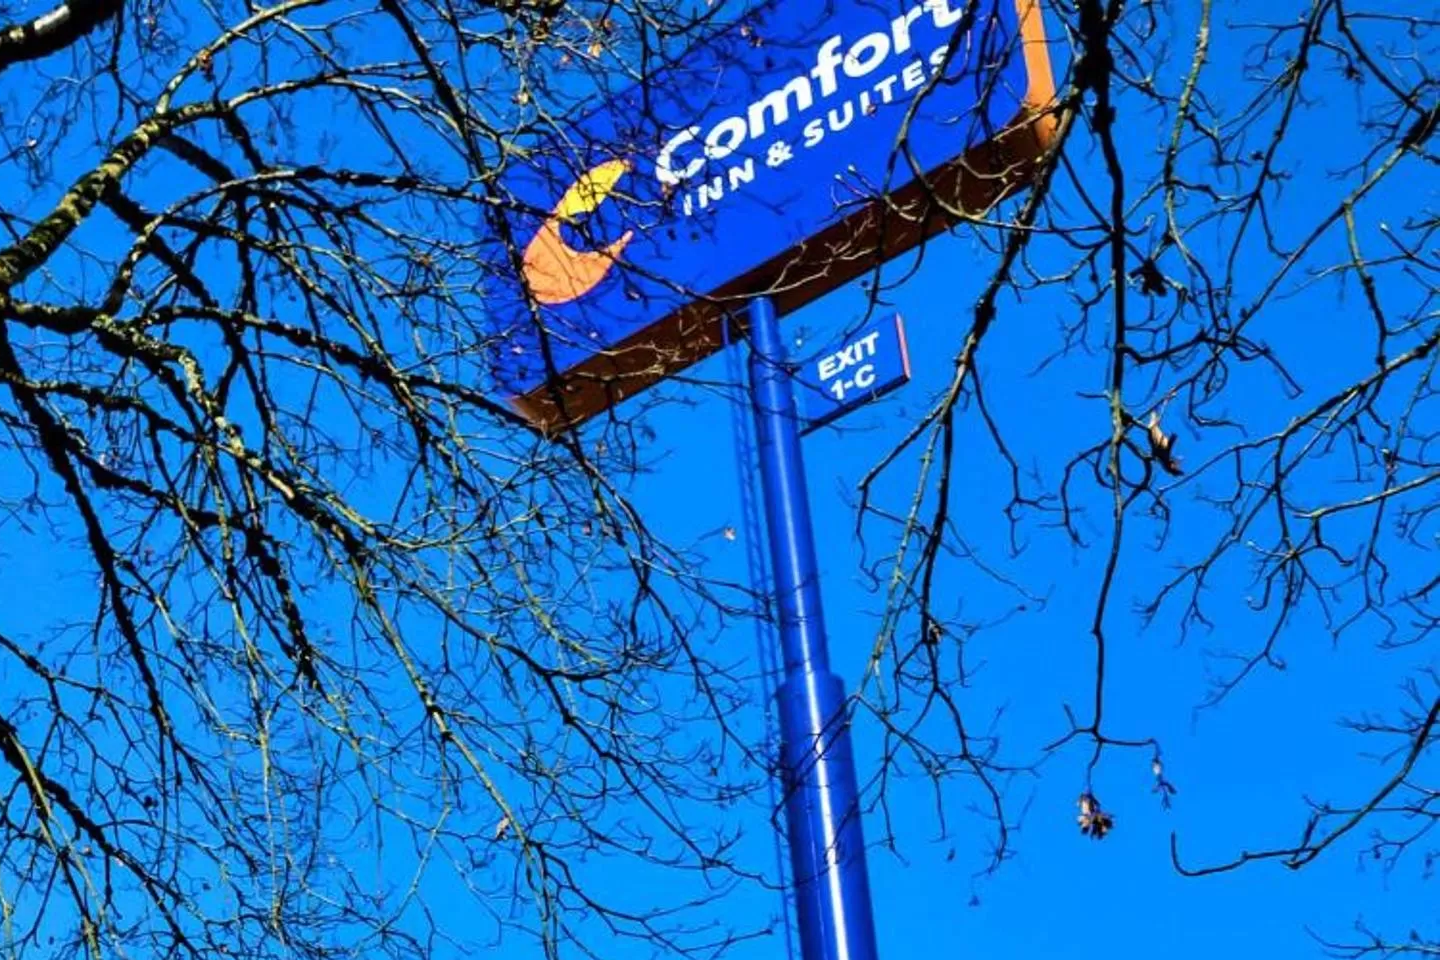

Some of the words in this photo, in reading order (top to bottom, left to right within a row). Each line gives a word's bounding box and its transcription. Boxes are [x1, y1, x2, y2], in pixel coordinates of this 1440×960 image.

[655, 0, 963, 185] Comfort
[683, 157, 755, 216] INN
[766, 140, 794, 168] &
[817, 330, 879, 381] EXIT
[830, 364, 875, 400] 1-C
